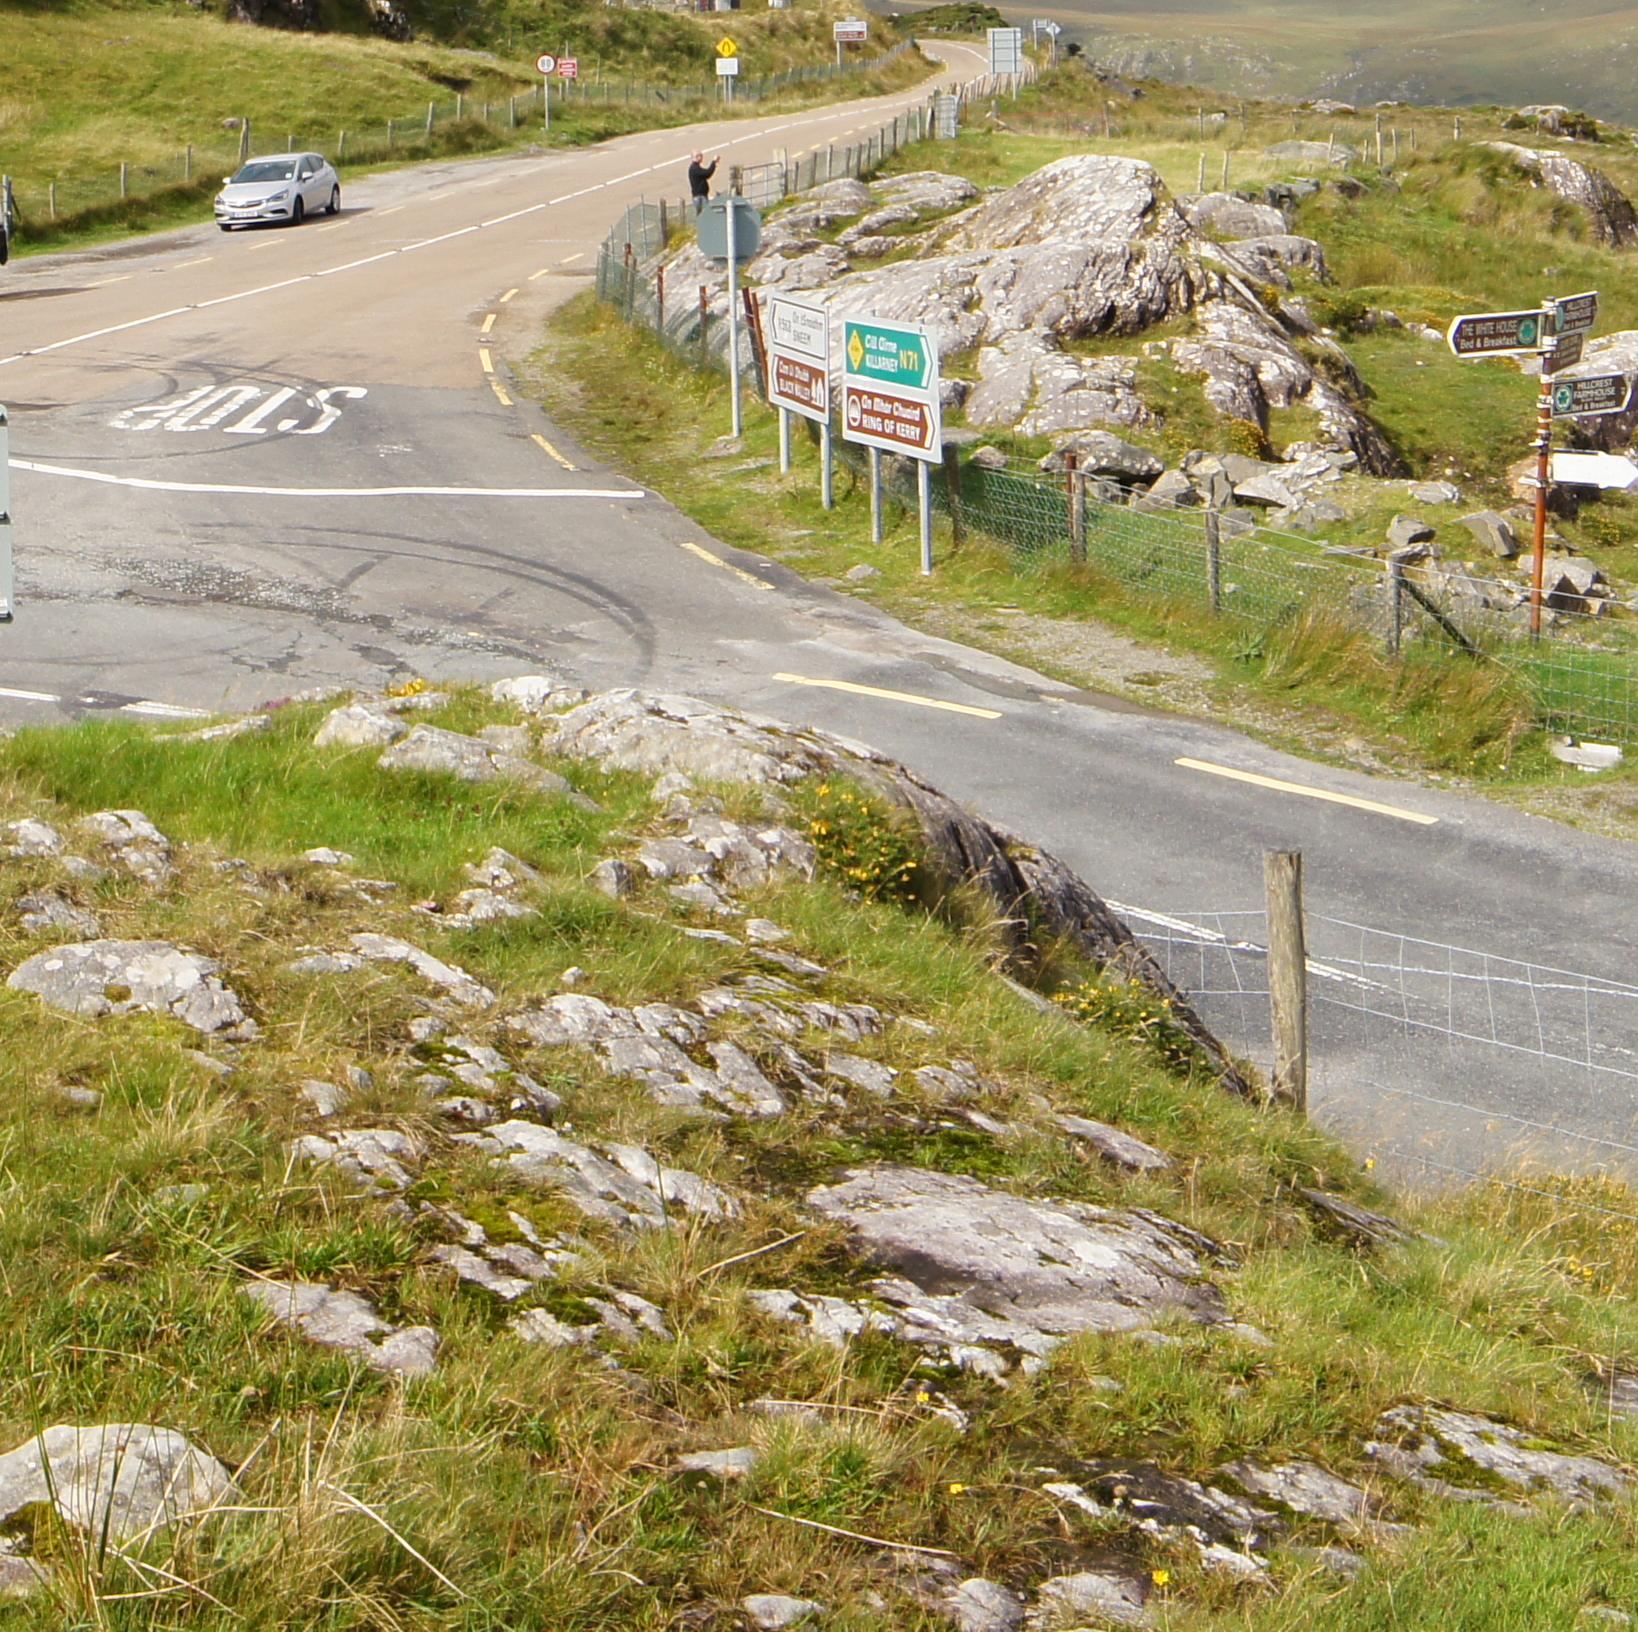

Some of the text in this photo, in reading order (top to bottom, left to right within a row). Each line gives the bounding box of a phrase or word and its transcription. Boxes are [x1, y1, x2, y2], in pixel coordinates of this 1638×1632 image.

[1461, 320, 1518, 336] THE WHITE HOUSE
[1460, 335, 1517, 349] Bed & Breakfast
[866, 354, 898, 373] KILLARNEY
[899, 349, 919, 371] N71
[1573, 386, 1615, 399] FARMHOUSE
[1577, 378, 1613, 390] HILLCREST
[107, 386, 367, 434] STOP
[862, 414, 921, 441] RING OF KERRY
